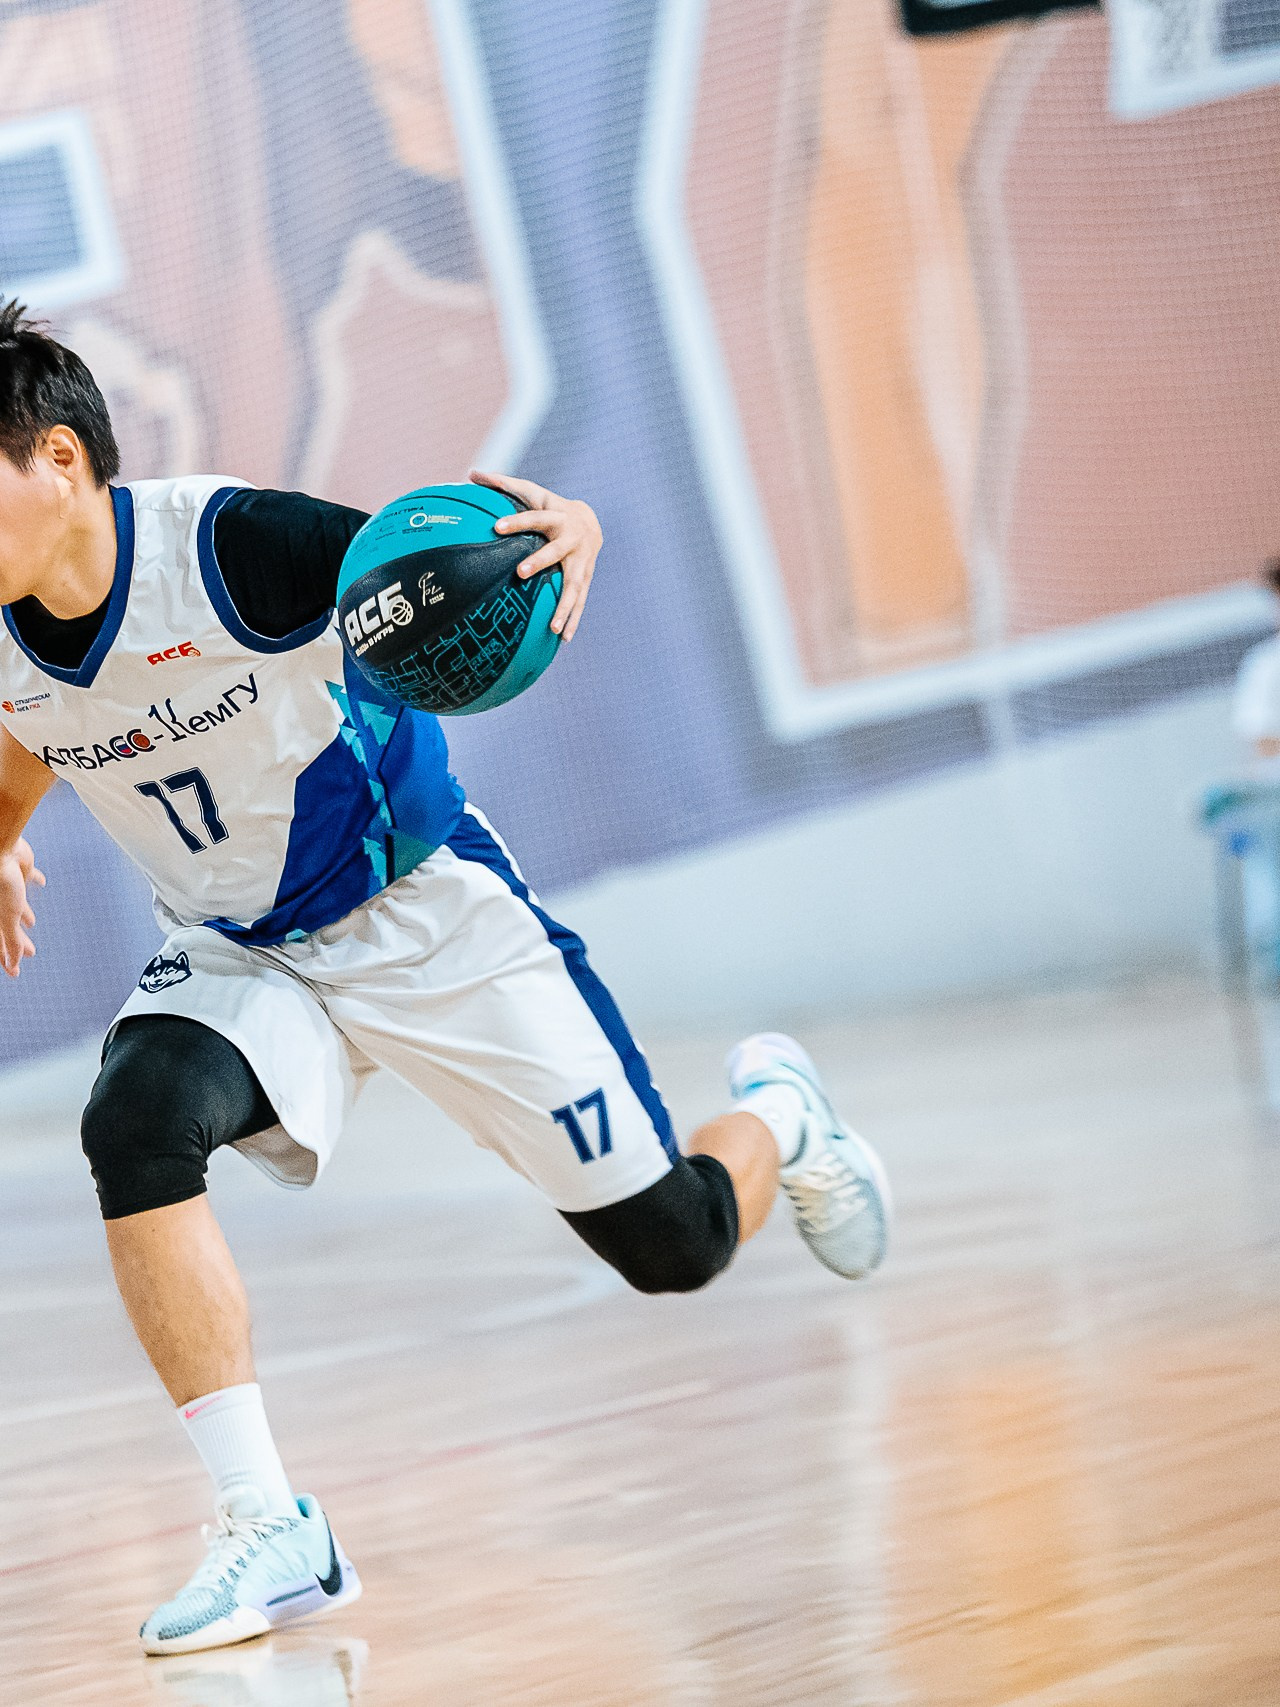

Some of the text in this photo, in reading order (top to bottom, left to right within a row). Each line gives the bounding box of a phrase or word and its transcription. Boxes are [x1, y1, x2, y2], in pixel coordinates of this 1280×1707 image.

[344, 581, 414, 648] АСБ
[147, 641, 201, 666] АСБ
[133, 766, 230, 855] 17
[550, 1087, 613, 1165] 17
